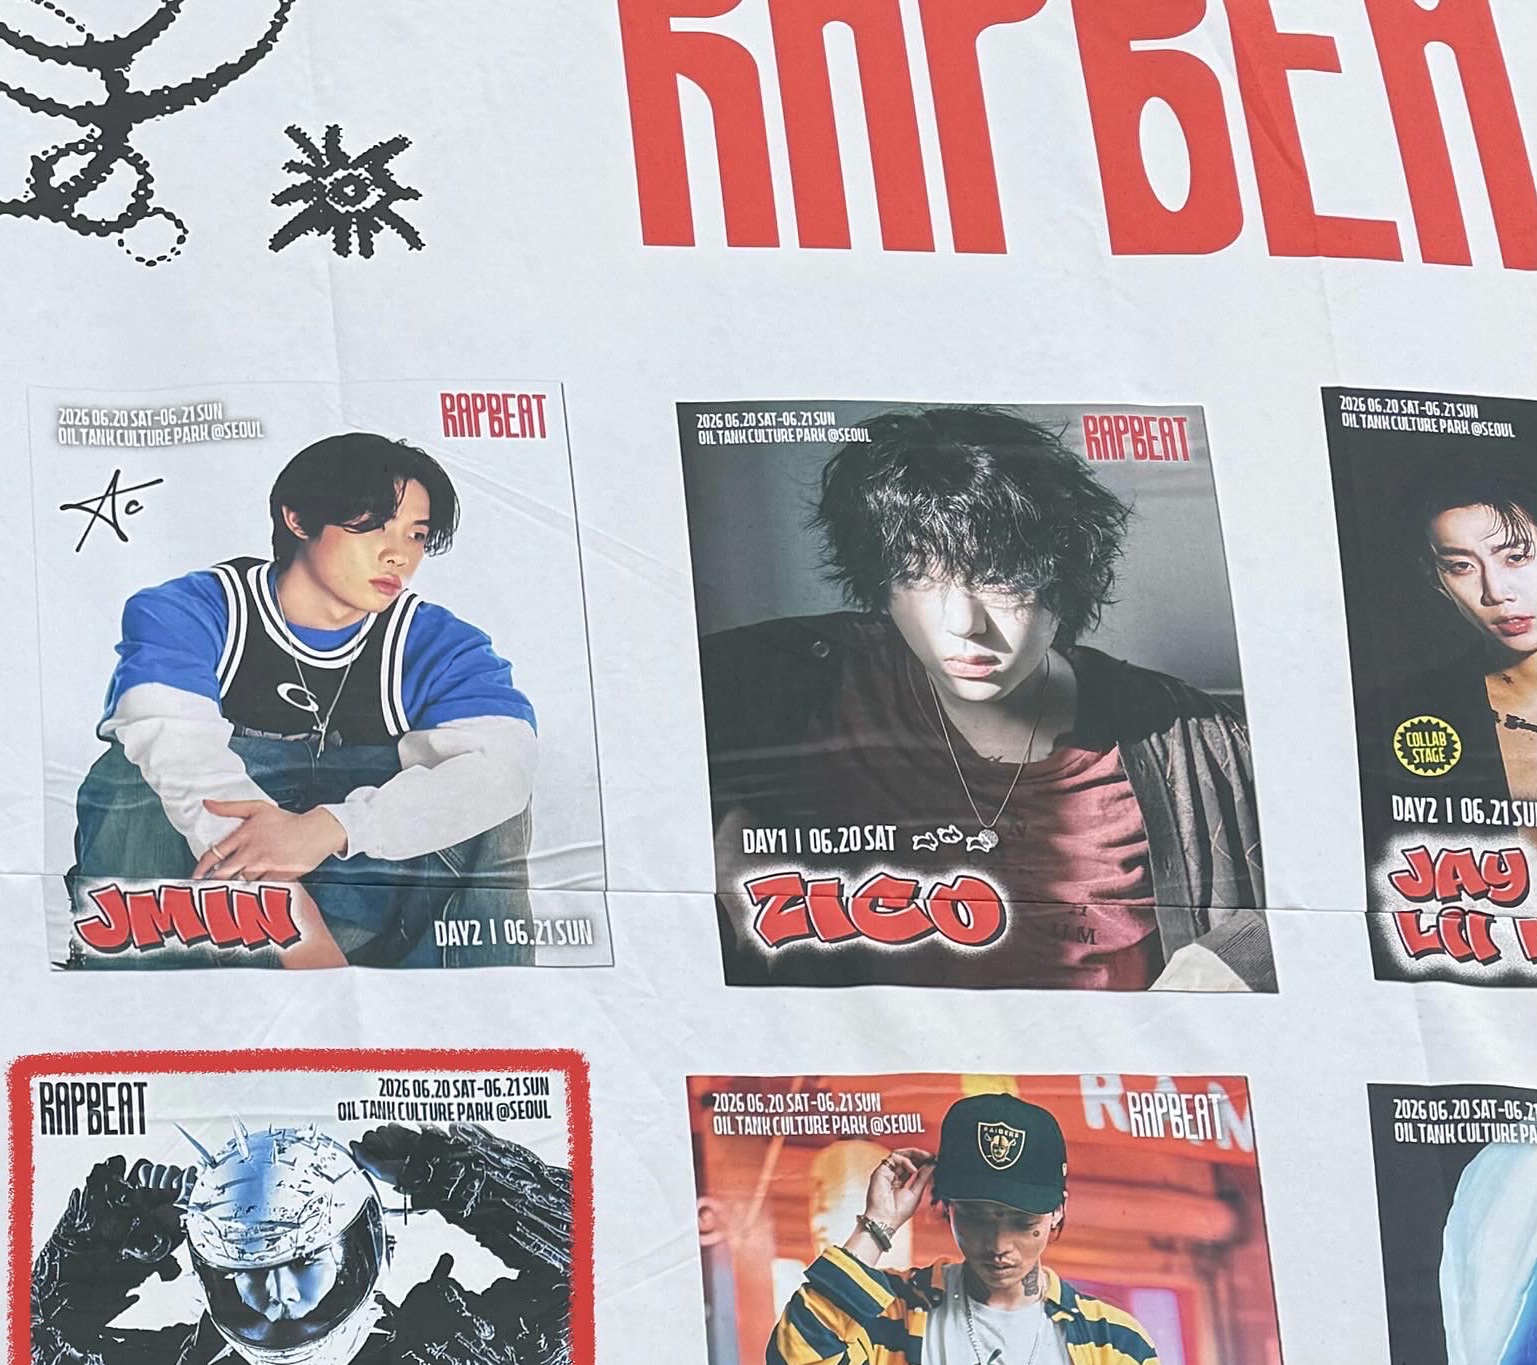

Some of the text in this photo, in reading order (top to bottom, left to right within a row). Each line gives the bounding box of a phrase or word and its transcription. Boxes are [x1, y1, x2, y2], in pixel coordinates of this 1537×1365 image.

[440, 393, 547, 438] RAPBEAT
[1083, 414, 1190, 462] RAPBEAT
[1406, 731, 1448, 747] COLLAB
[1412, 747, 1446, 763] STAGE
[1392, 795, 1438, 823] DAY2
[1460, 798, 1511, 826] 06.21
[742, 825, 897, 854] DAY1 06.20 SAT
[434, 920, 594, 946] DAY2 06.21 SUN
[39, 1082, 147, 1135] RAPBEAT
[1126, 1091, 1223, 1140] RAPBEAT
